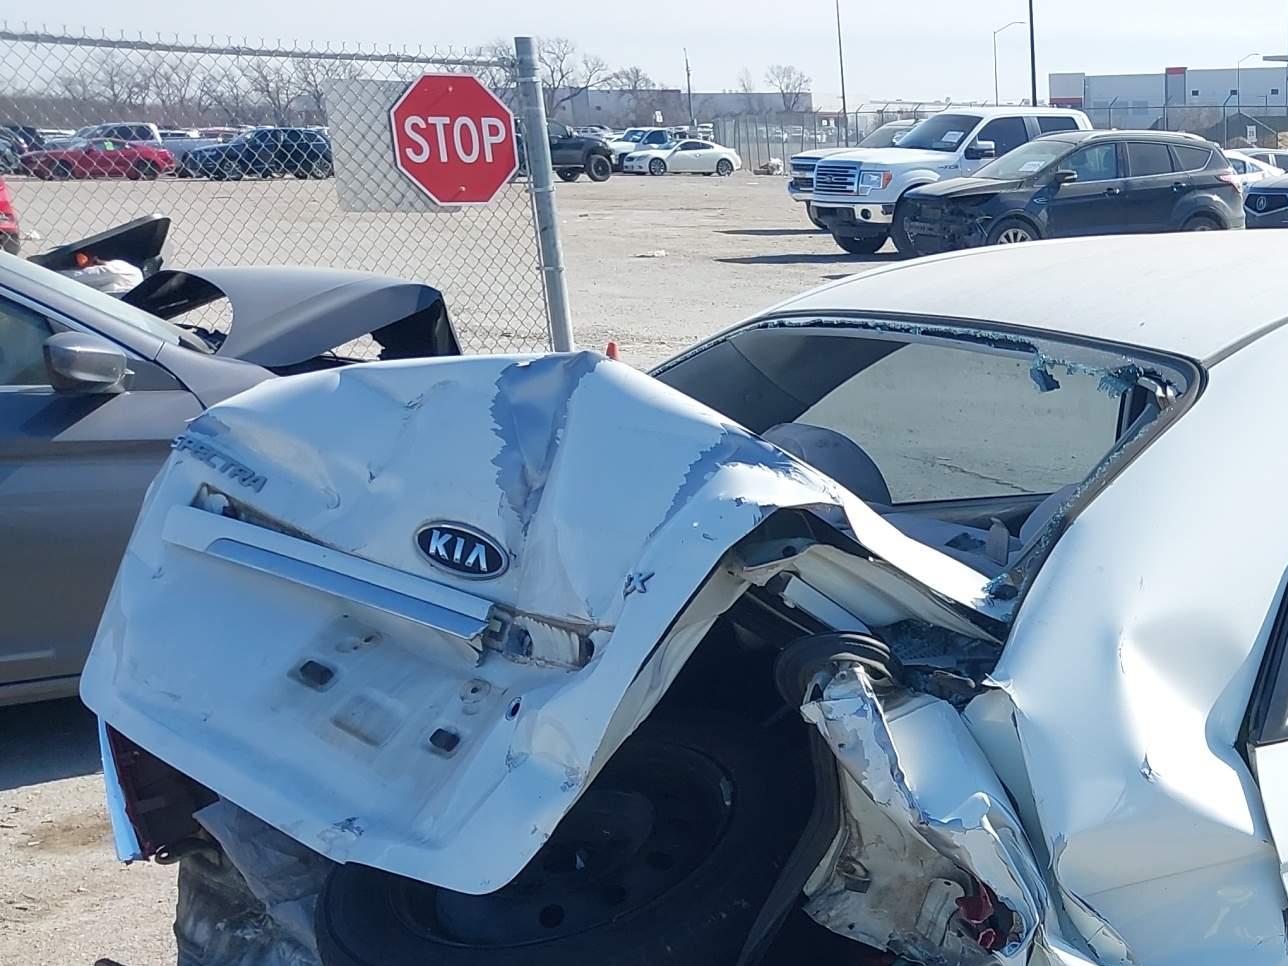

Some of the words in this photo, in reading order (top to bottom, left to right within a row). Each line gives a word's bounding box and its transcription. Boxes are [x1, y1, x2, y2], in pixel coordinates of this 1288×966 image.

[404, 115, 506, 164] STOP
[170, 434, 268, 493] SPECTRA
[428, 529, 488, 572] KIA
